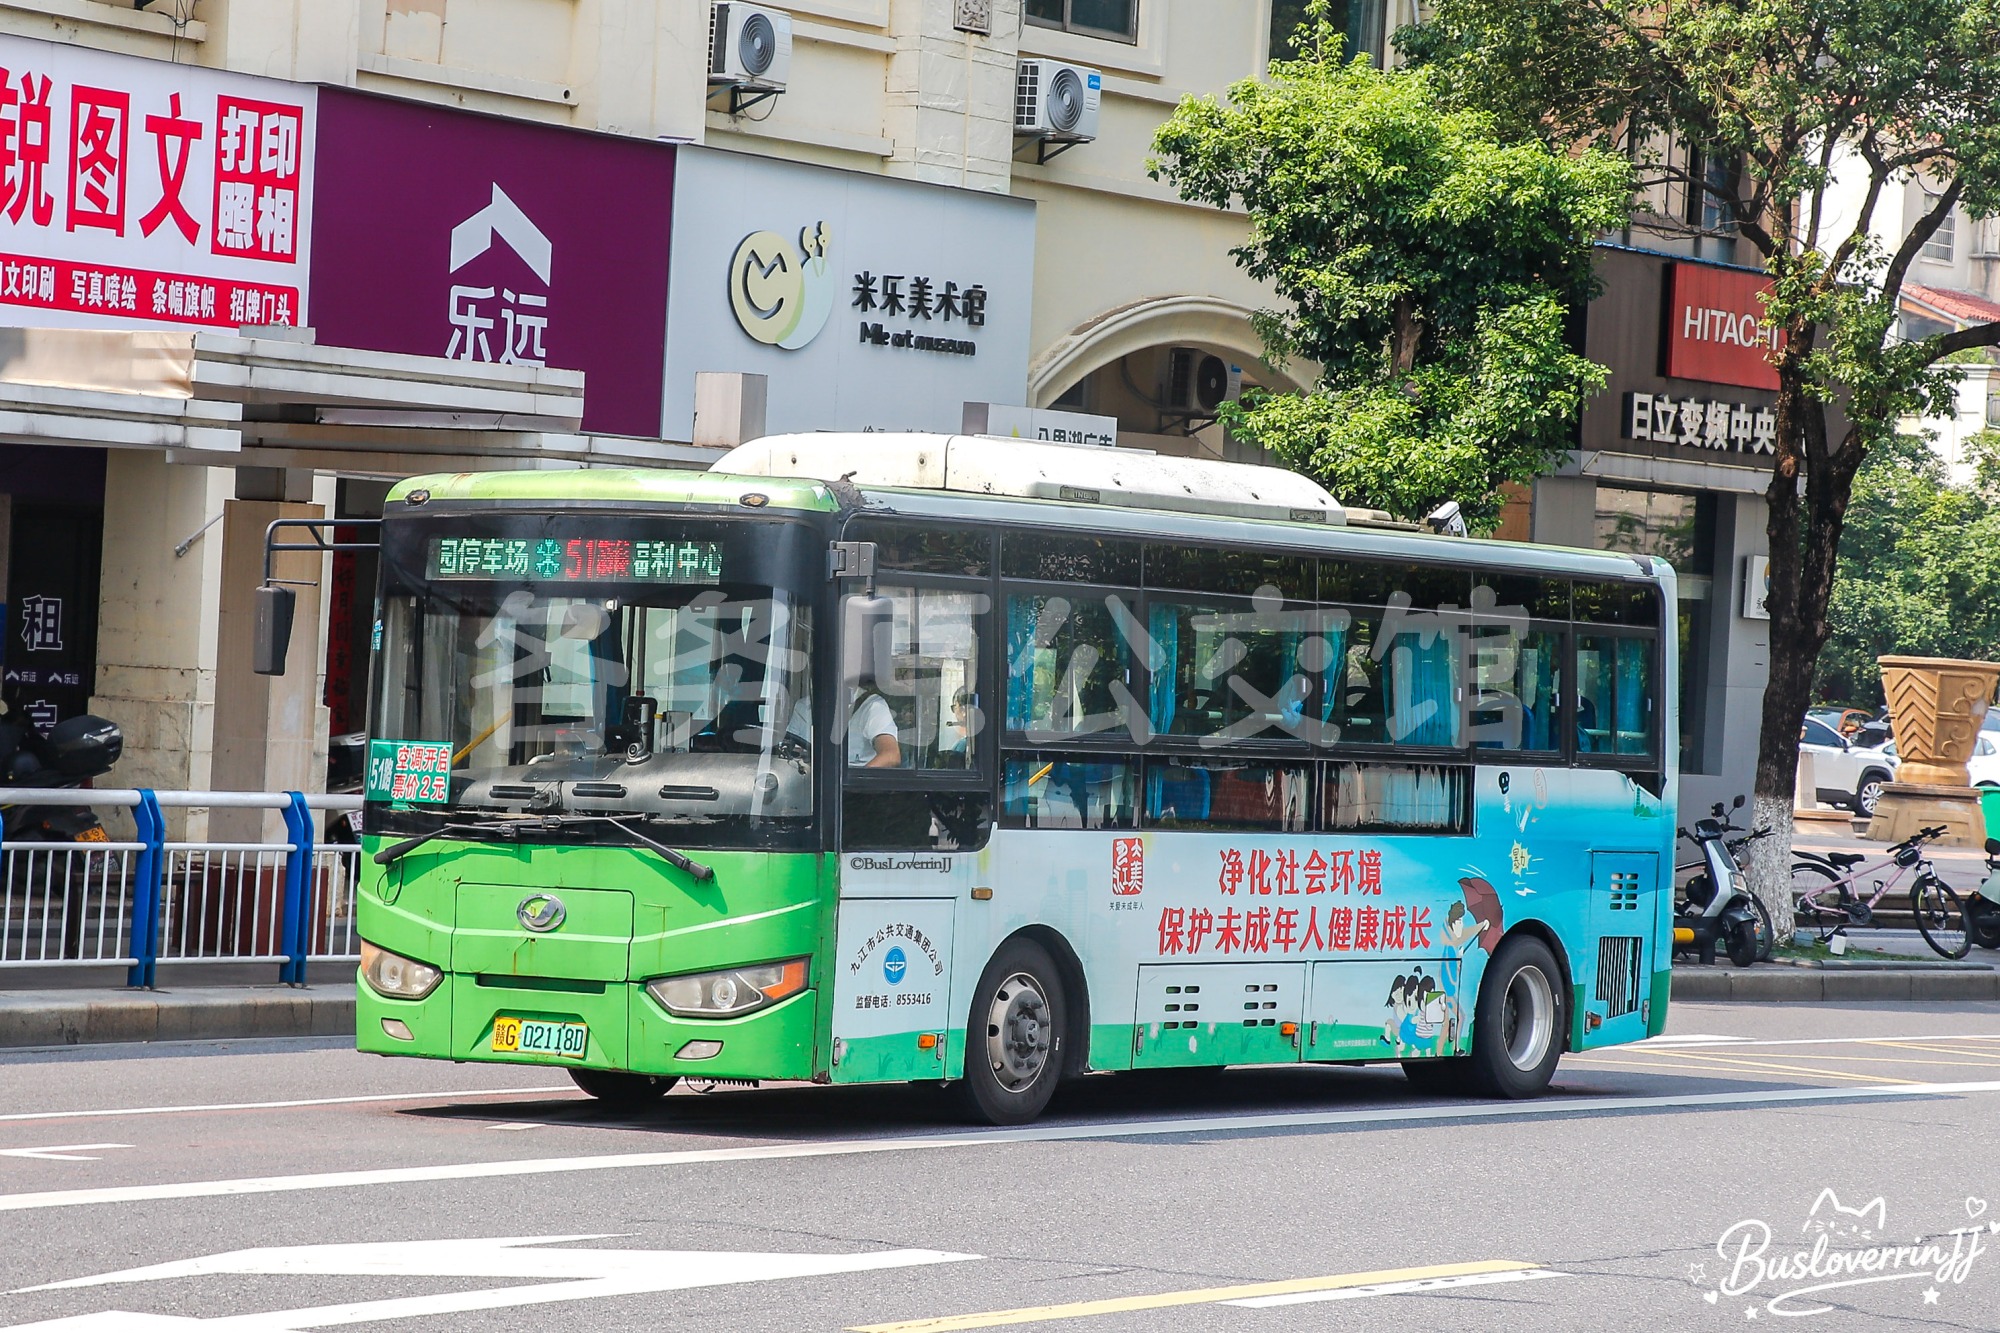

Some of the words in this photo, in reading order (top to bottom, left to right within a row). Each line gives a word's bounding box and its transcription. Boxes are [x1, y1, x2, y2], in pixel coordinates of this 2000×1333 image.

[0, 66, 203, 246] 锐图文
[220, 106, 298, 179] 打印
[216, 181, 294, 255] 照相
[0, 261, 55, 302] 文印刷
[71, 270, 137, 311] 写真喷绘
[152, 278, 216, 319] 条幅旗帜
[230, 287, 291, 326] 招牌门头
[852, 271, 987, 326] 米乐美术馆
[445, 285, 548, 367] 乐远
[1631, 393, 1807, 458] 日立变频中央
[396, 745, 450, 773] 空调开启
[1218, 848, 1383, 896] 净化社会环境
[850, 922, 944, 977] 九江市公共交通集团公司
[1158, 904, 1433, 957] 保护未成年人健康成长
[896, 993, 931, 1006] 8553416
